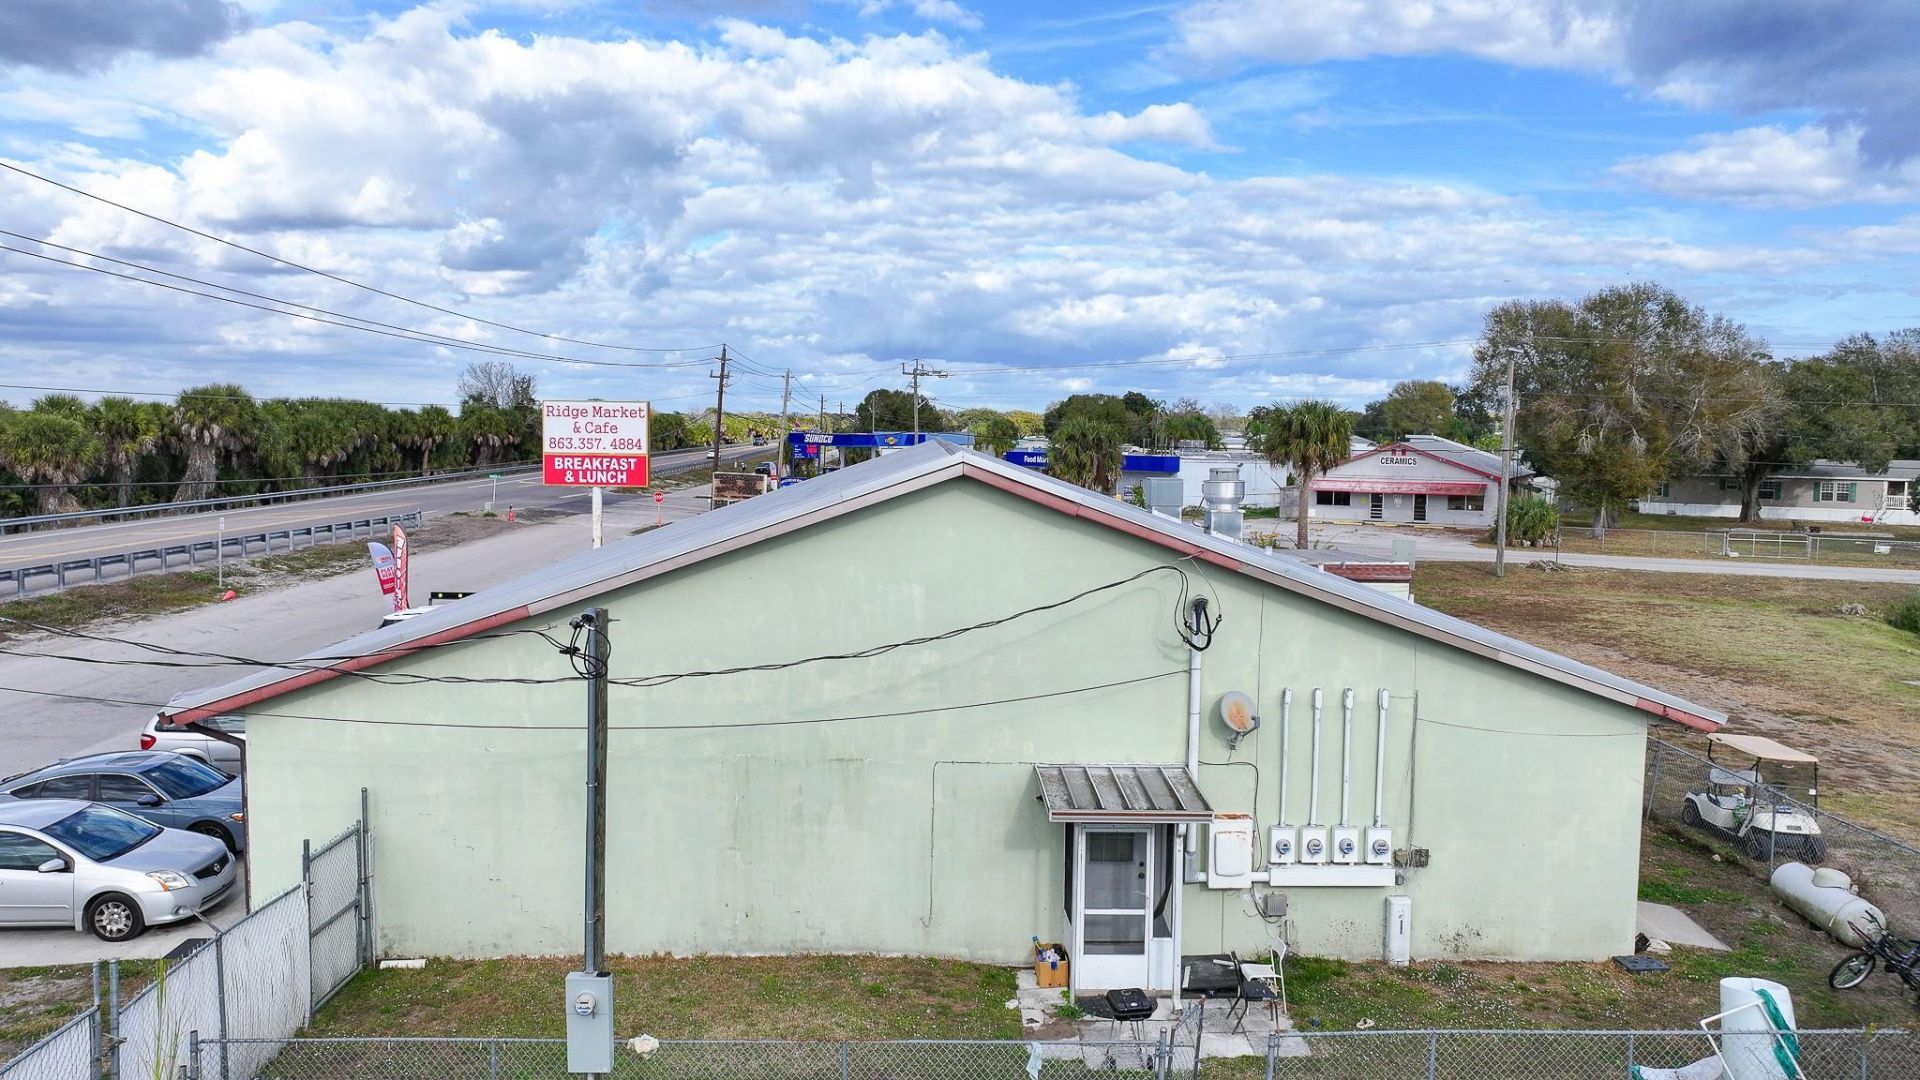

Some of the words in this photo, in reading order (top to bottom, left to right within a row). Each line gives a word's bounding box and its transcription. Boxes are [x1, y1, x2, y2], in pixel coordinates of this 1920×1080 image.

[545, 405, 589, 419] Ridge
[592, 406, 646, 419] Market
[573, 421, 581, 433] &
[584, 421, 618, 434] Cafe
[804, 433, 834, 444] SUNOCO
[554, 457, 637, 471] BREAKFAST
[1023, 455, 1037, 463] Food
[1380, 456, 1418, 466] CERAMICS
[564, 470, 575, 483] &
[578, 471, 627, 483] LUNCH
